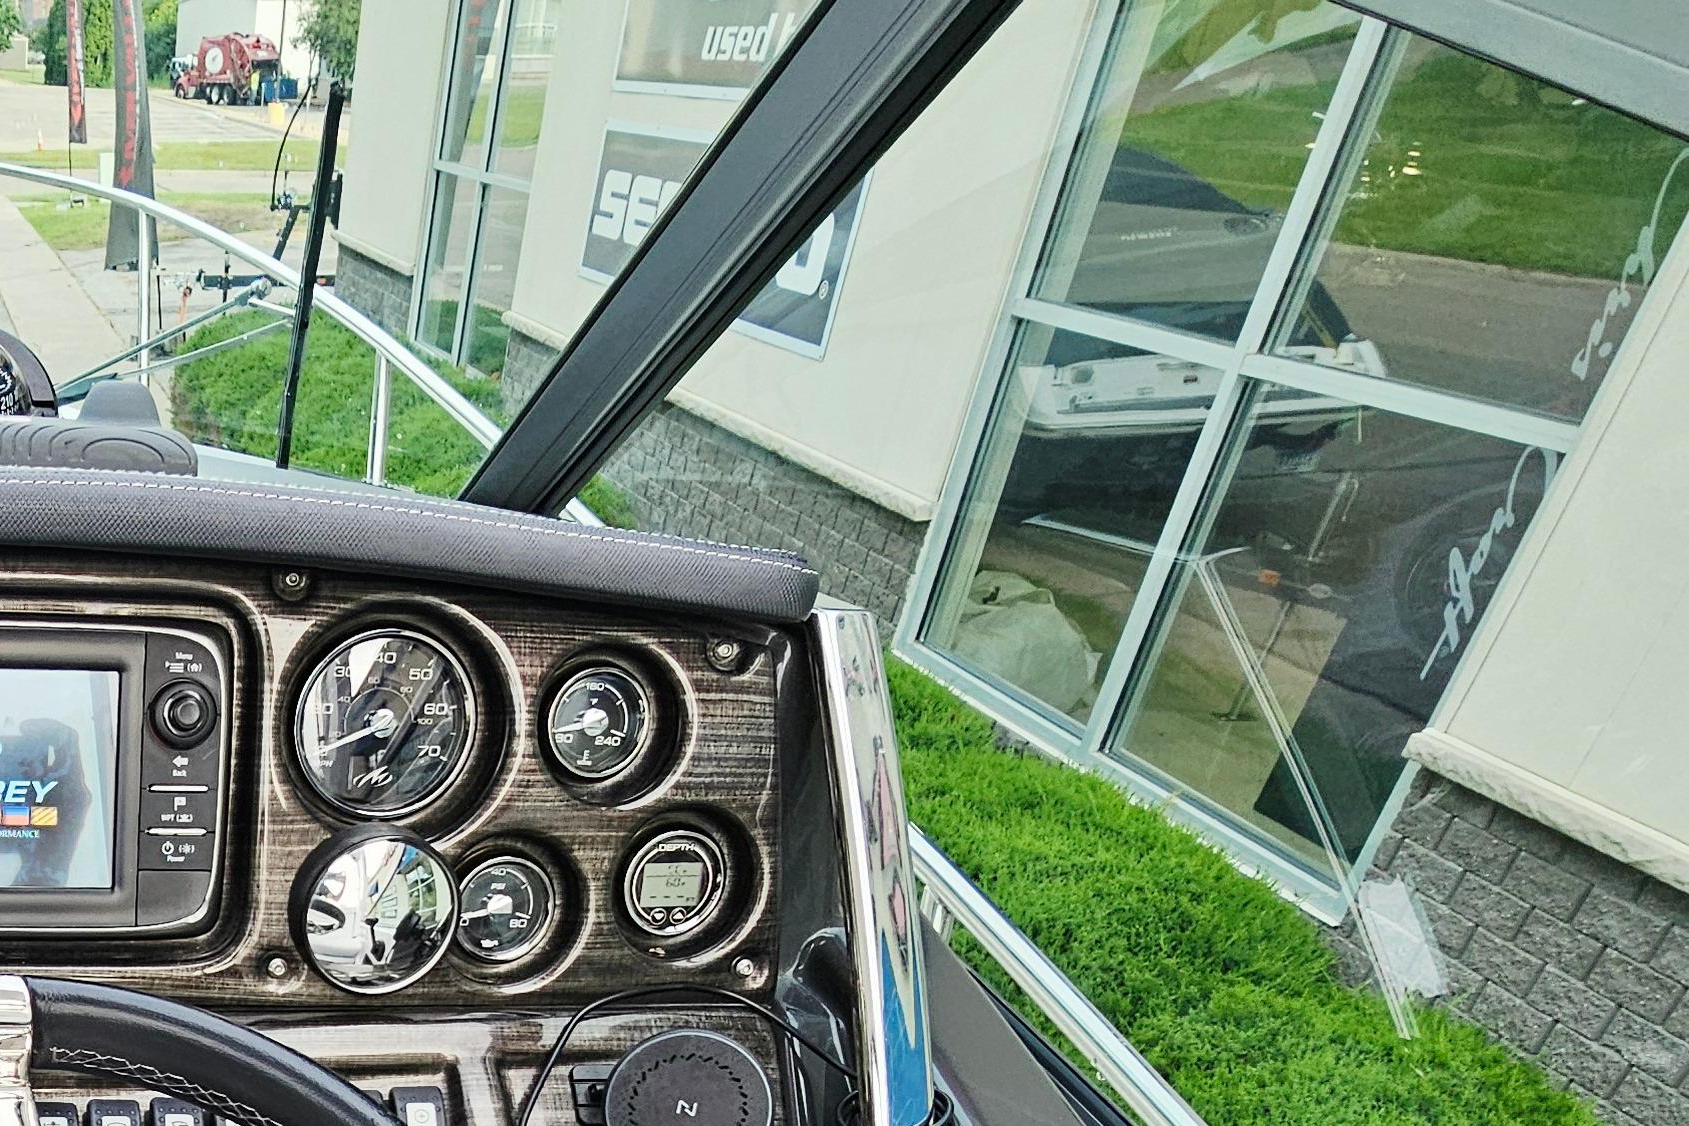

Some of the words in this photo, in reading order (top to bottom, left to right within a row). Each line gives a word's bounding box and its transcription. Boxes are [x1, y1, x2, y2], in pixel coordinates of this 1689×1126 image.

[701, 13, 778, 62] used
[0, 392, 13, 409] 210
[408, 668, 433, 680] 50
[424, 703, 448, 715] 60
[594, 736, 621, 746] 240
[417, 745, 441, 758] 70
[658, 843, 695, 852] DEPTH
[491, 867, 507, 876] 40
